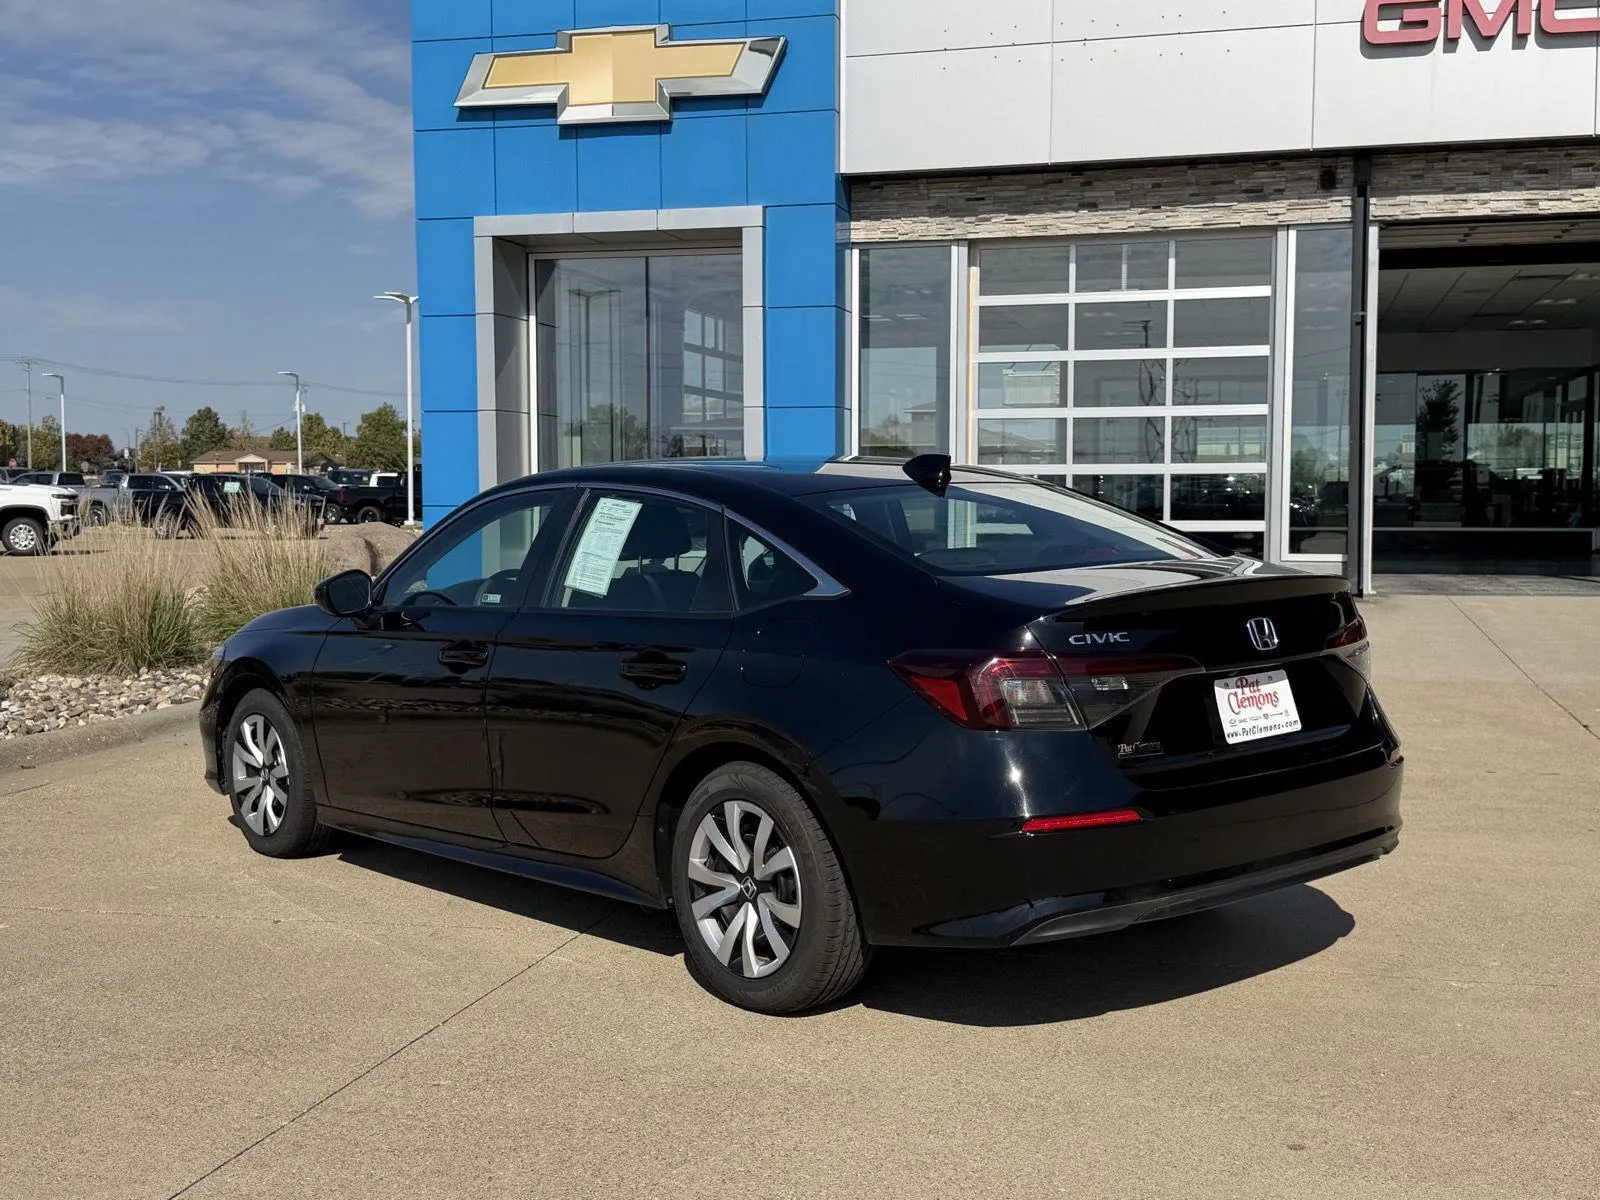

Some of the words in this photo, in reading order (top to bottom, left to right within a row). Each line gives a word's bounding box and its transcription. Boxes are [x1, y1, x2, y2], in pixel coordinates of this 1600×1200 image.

[1363, 0, 1600, 45] GMC
[1069, 632, 1130, 645] CIVIC
[1235, 676, 1261, 695] Pat
[1227, 691, 1279, 715] Clemons
[1227, 720, 1299, 738] www.PatClemons.com
